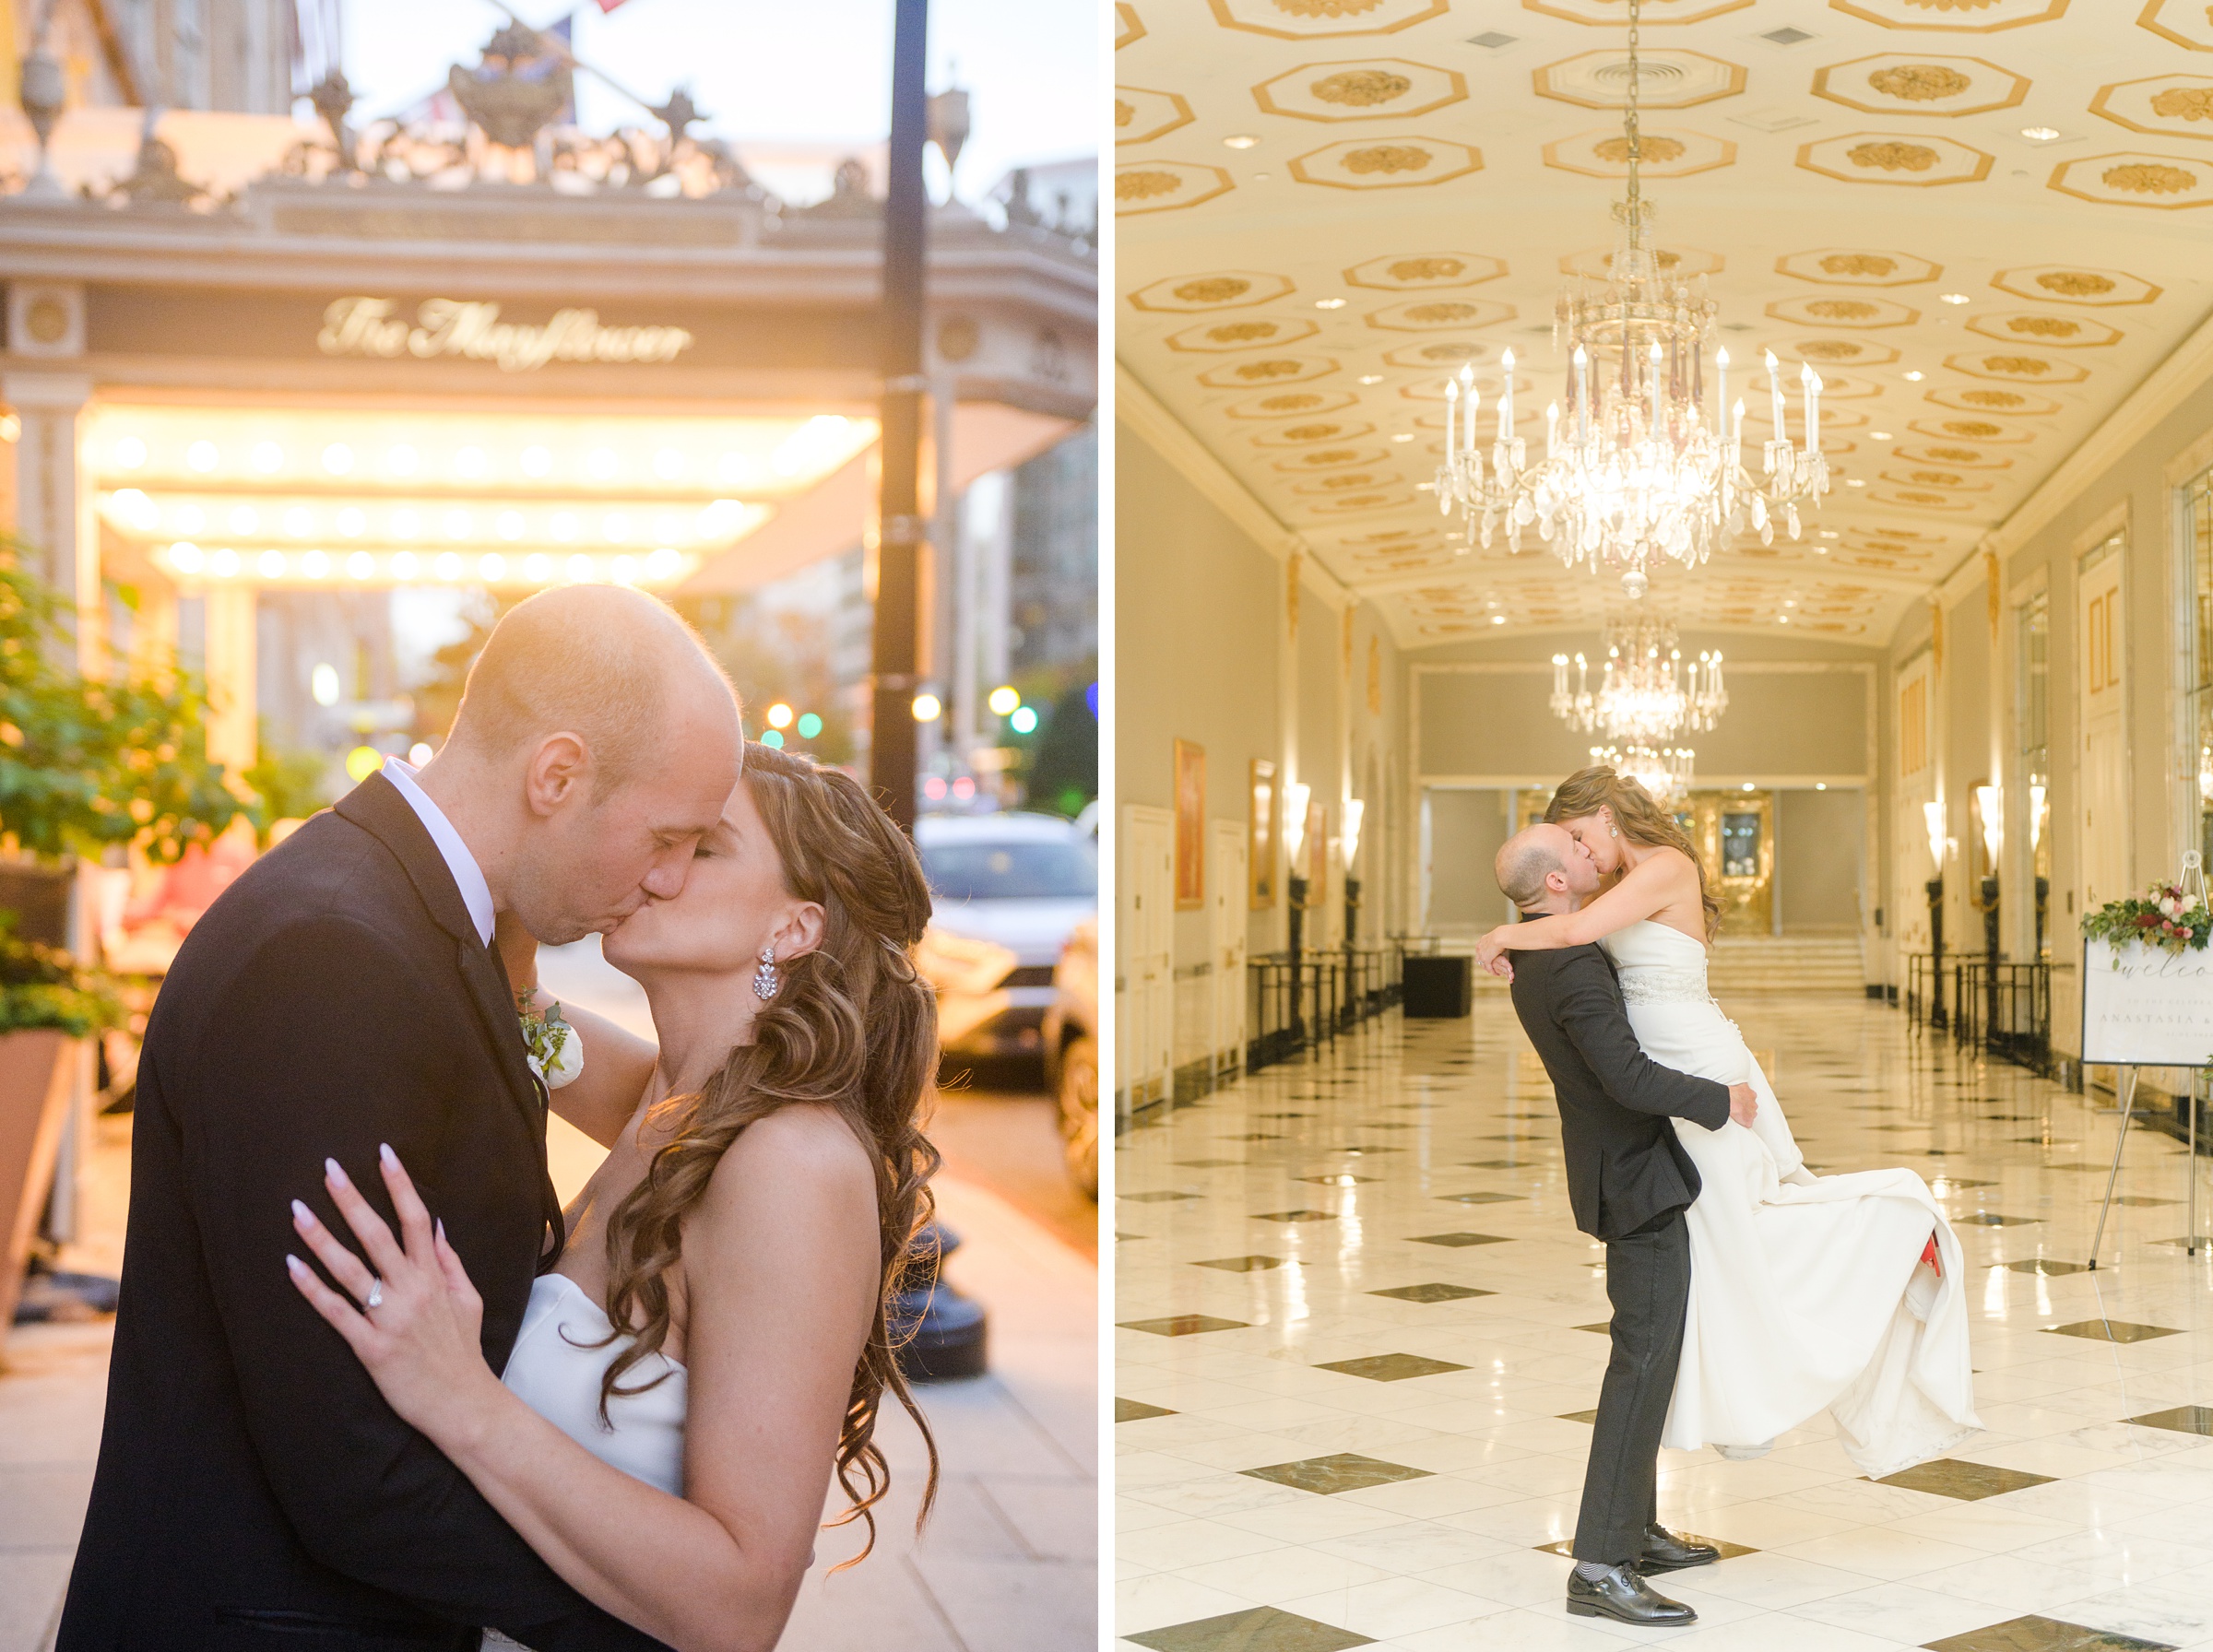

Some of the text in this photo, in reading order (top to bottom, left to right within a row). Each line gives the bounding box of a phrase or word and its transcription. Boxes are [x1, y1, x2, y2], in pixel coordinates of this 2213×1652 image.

[316, 297, 693, 372] The Mayflower
[2100, 1013, 2194, 1024] ANASTASIA
